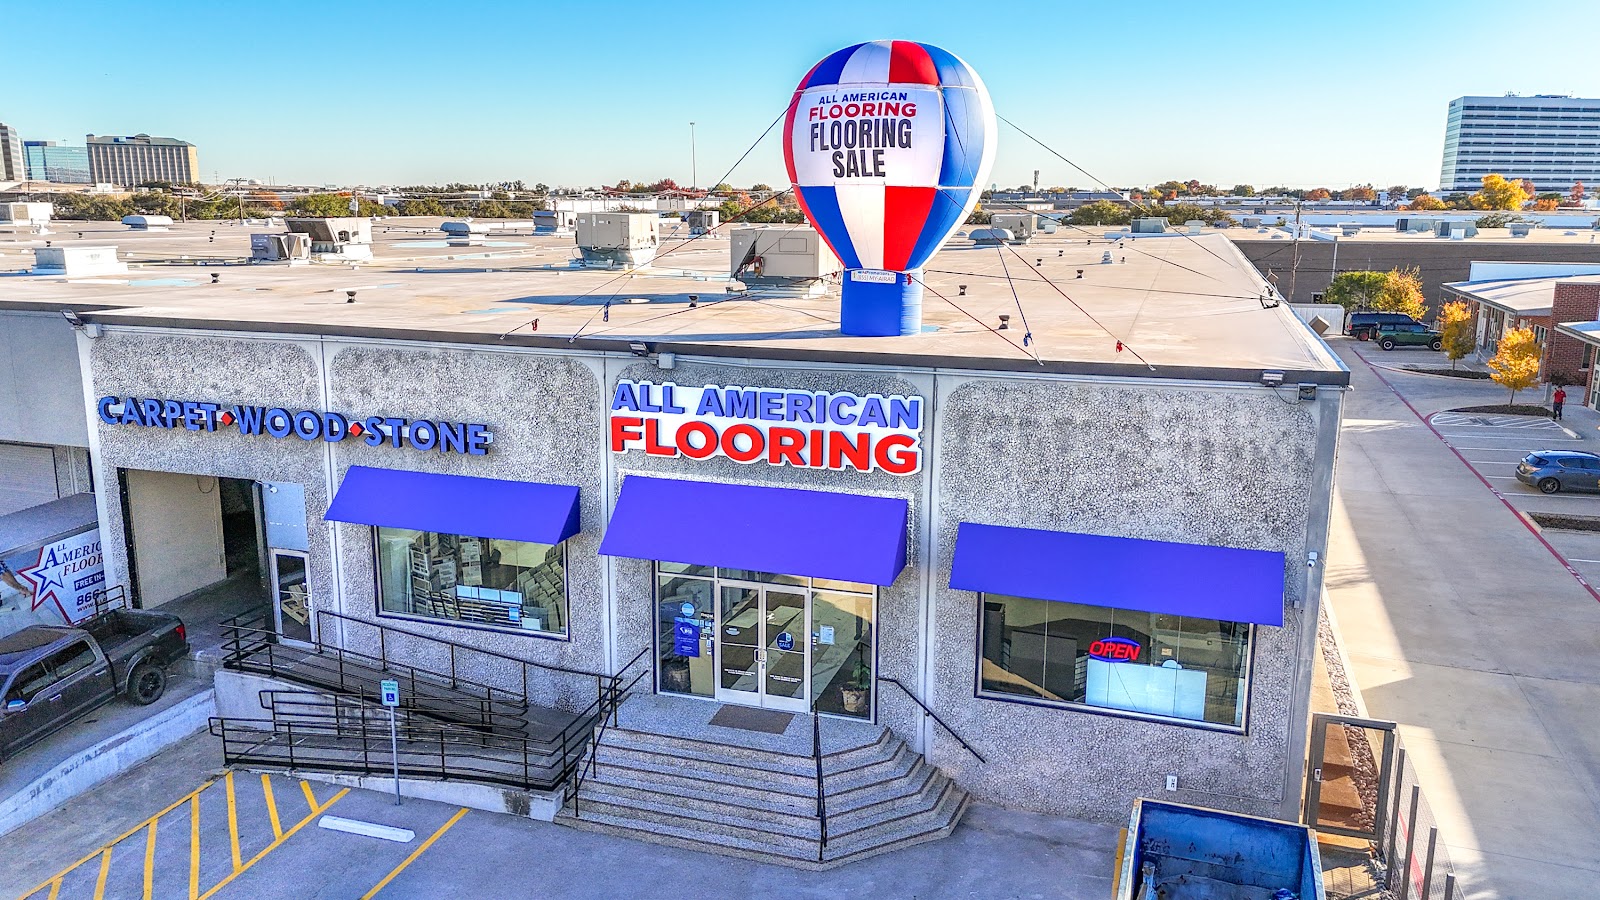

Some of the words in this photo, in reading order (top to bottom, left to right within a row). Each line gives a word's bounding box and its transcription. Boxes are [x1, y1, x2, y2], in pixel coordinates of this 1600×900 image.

[809, 102, 917, 122] FLOORING
[819, 95, 838, 105] ALL
[842, 92, 907, 103] AMERICAN
[810, 118, 912, 152] FLOORING
[832, 149, 886, 178] SALE
[611, 383, 686, 414] ALL
[696, 388, 919, 429] AMERICAN
[98, 396, 221, 433] CARPET
[233, 405, 348, 443] WOOD
[364, 416, 489, 456] STONE
[611, 416, 919, 474] FLOORING
[75, 577, 94, 589] FREE
[1089, 641, 1141, 661] OPEN
